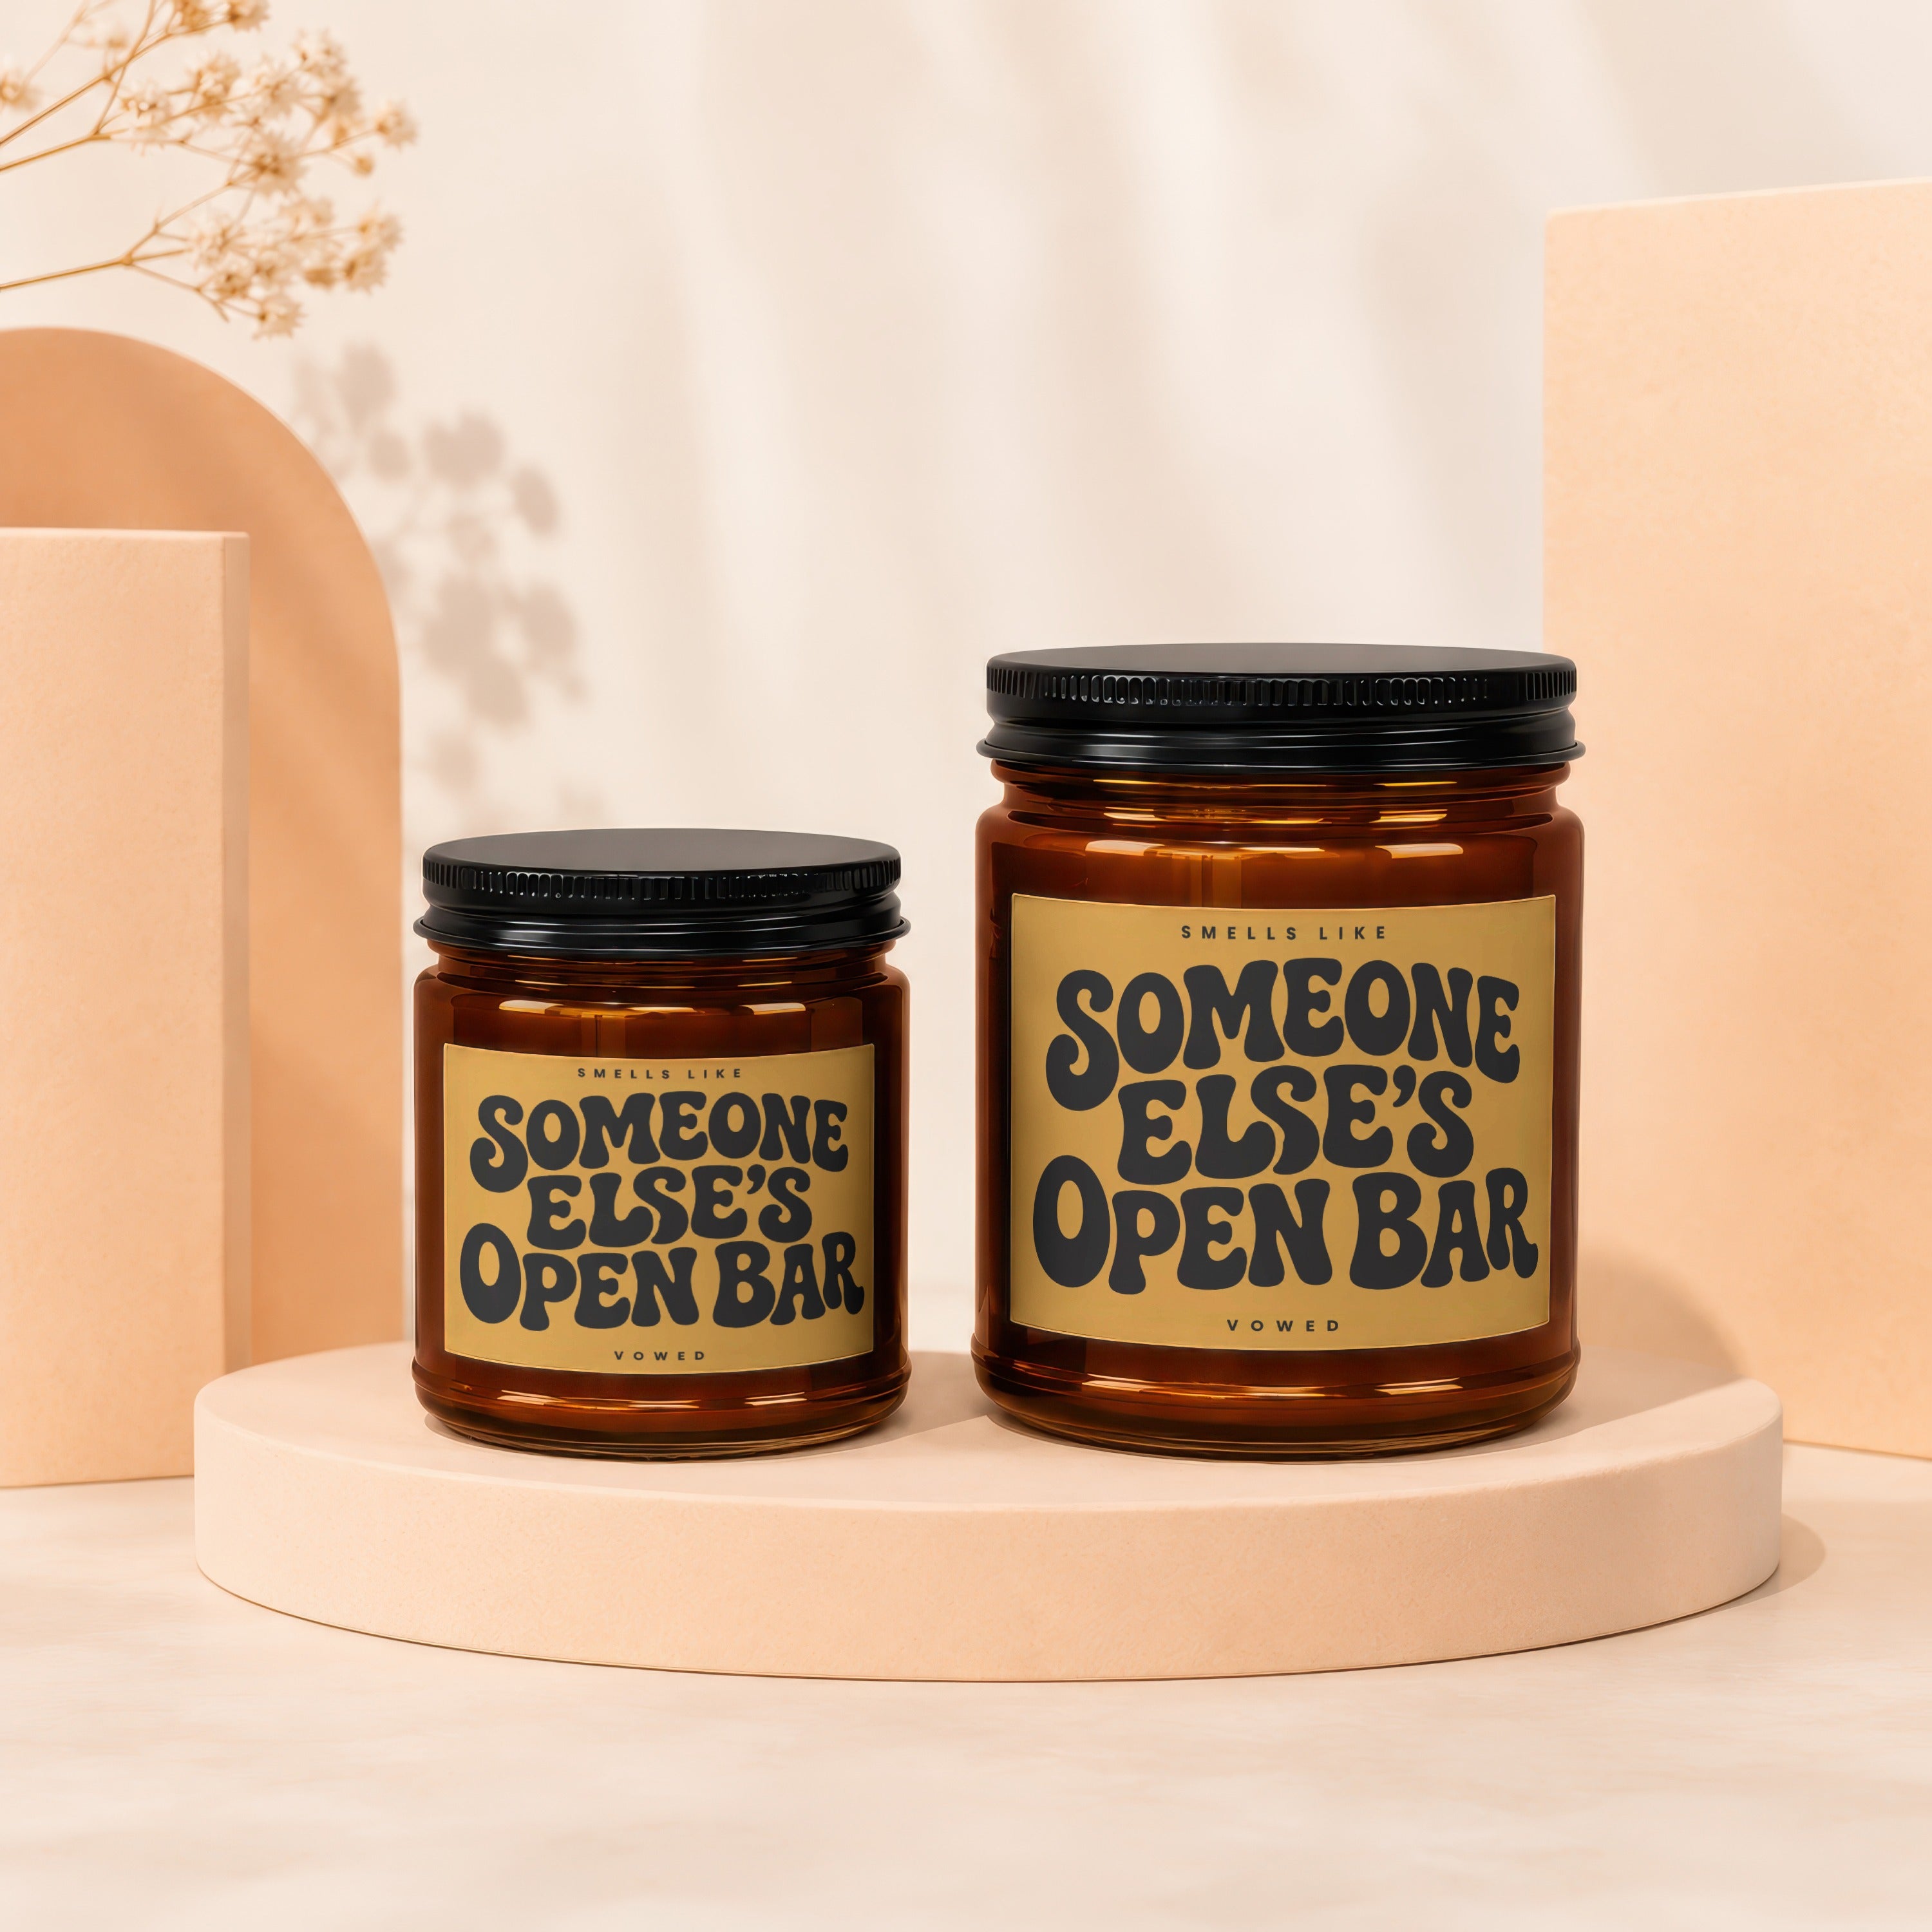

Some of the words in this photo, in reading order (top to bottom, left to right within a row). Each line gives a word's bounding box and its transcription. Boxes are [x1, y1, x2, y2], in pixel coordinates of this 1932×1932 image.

[1181, 925, 1296, 941] SMELLS
[1319, 925, 1385, 940] LIKE
[578, 1068, 670, 1079] SMELLS
[688, 1068, 741, 1079] LIKE
[1045, 957, 1520, 1112] SOMEONE
[469, 1090, 849, 1193] SOMEONE
[1117, 1064, 1475, 1186] ELSE’S
[526, 1164, 813, 1251] ELSE’S
[1032, 1154, 1333, 1295] OPEN
[1349, 1167, 1539, 1291] BAR
[459, 1222, 700, 1332] OPEN
[712, 1231, 866, 1329] BAR
[614, 1350, 705, 1361] VOWED
[1226, 1319, 1339, 1332] VOWED
